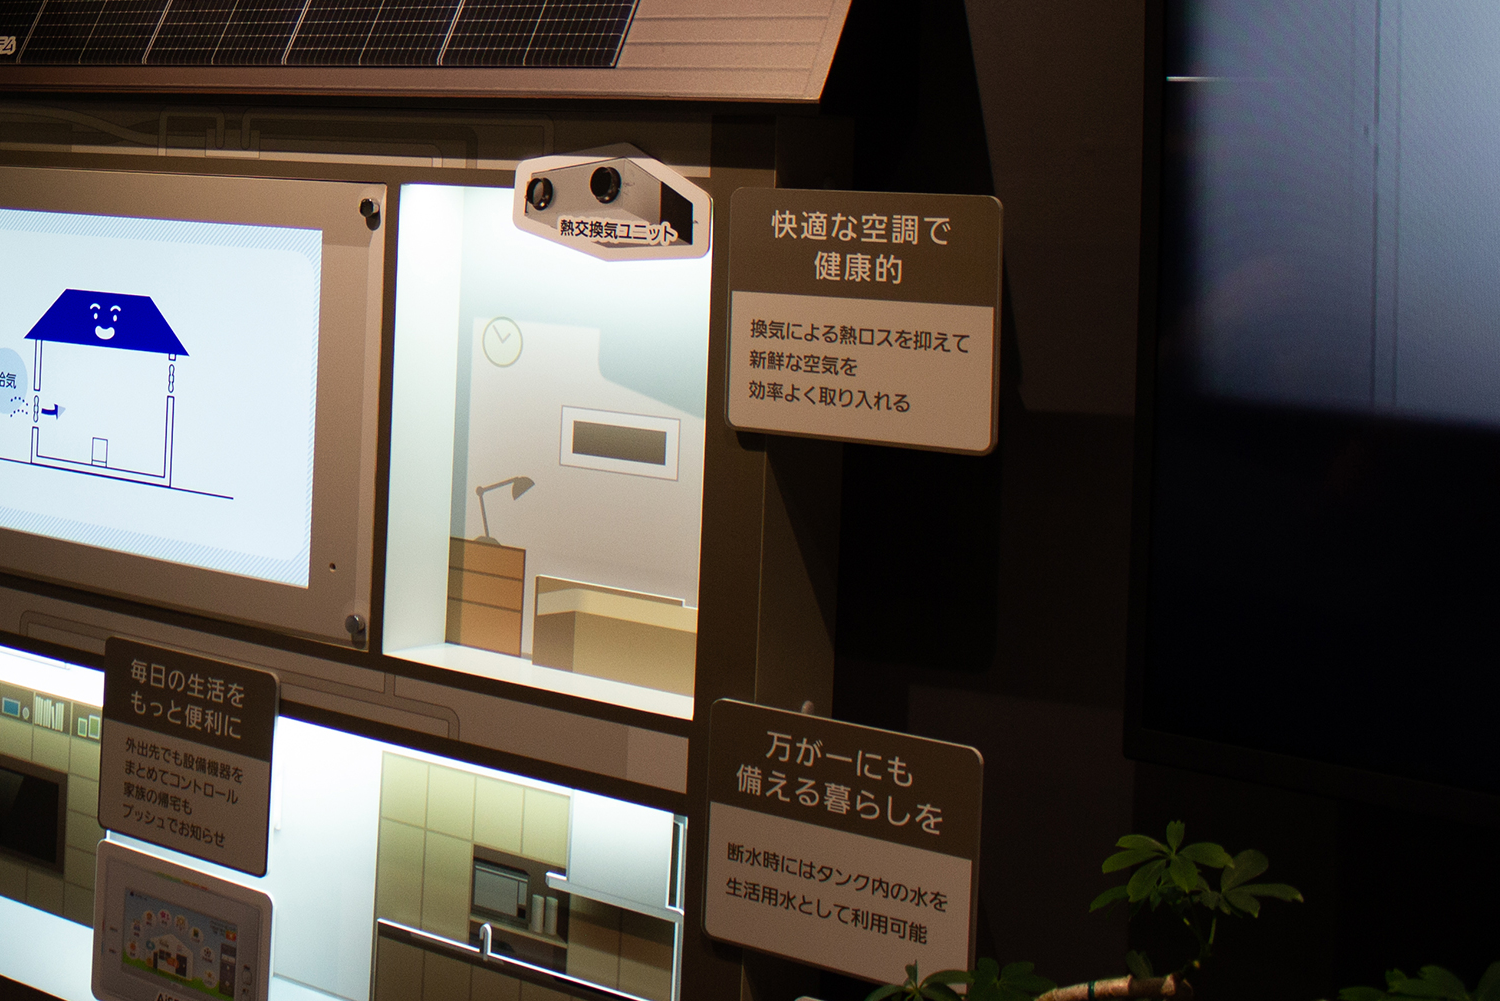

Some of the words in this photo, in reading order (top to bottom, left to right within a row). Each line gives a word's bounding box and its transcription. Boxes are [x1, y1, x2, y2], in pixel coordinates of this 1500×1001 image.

[560, 218, 676, 244] 熱交換気ユニット
[771, 209, 952, 246] 快適な空調で
[813, 250, 903, 285] 健康的
[749, 318, 971, 354] 換気による熱ロスを抑えて
[748, 350, 858, 377] 新鮮な空気を
[748, 380, 912, 413] 効率よく取り入れる
[130, 658, 245, 708] 毎日の生活を
[130, 690, 242, 739] もっと便利に
[125, 737, 243, 783] 外出先でも設備機器を
[765, 730, 913, 788] 万が一にも
[123, 781, 192, 815] 家族の帰宅も
[125, 760, 238, 804] まとめてコントロール
[736, 763, 944, 835] 備える暮らしを
[123, 804, 225, 848] プッシュでお知らせ
[726, 842, 948, 912] 断水時にはタンク内の水を
[725, 876, 928, 944] 生活用水として利用可能
